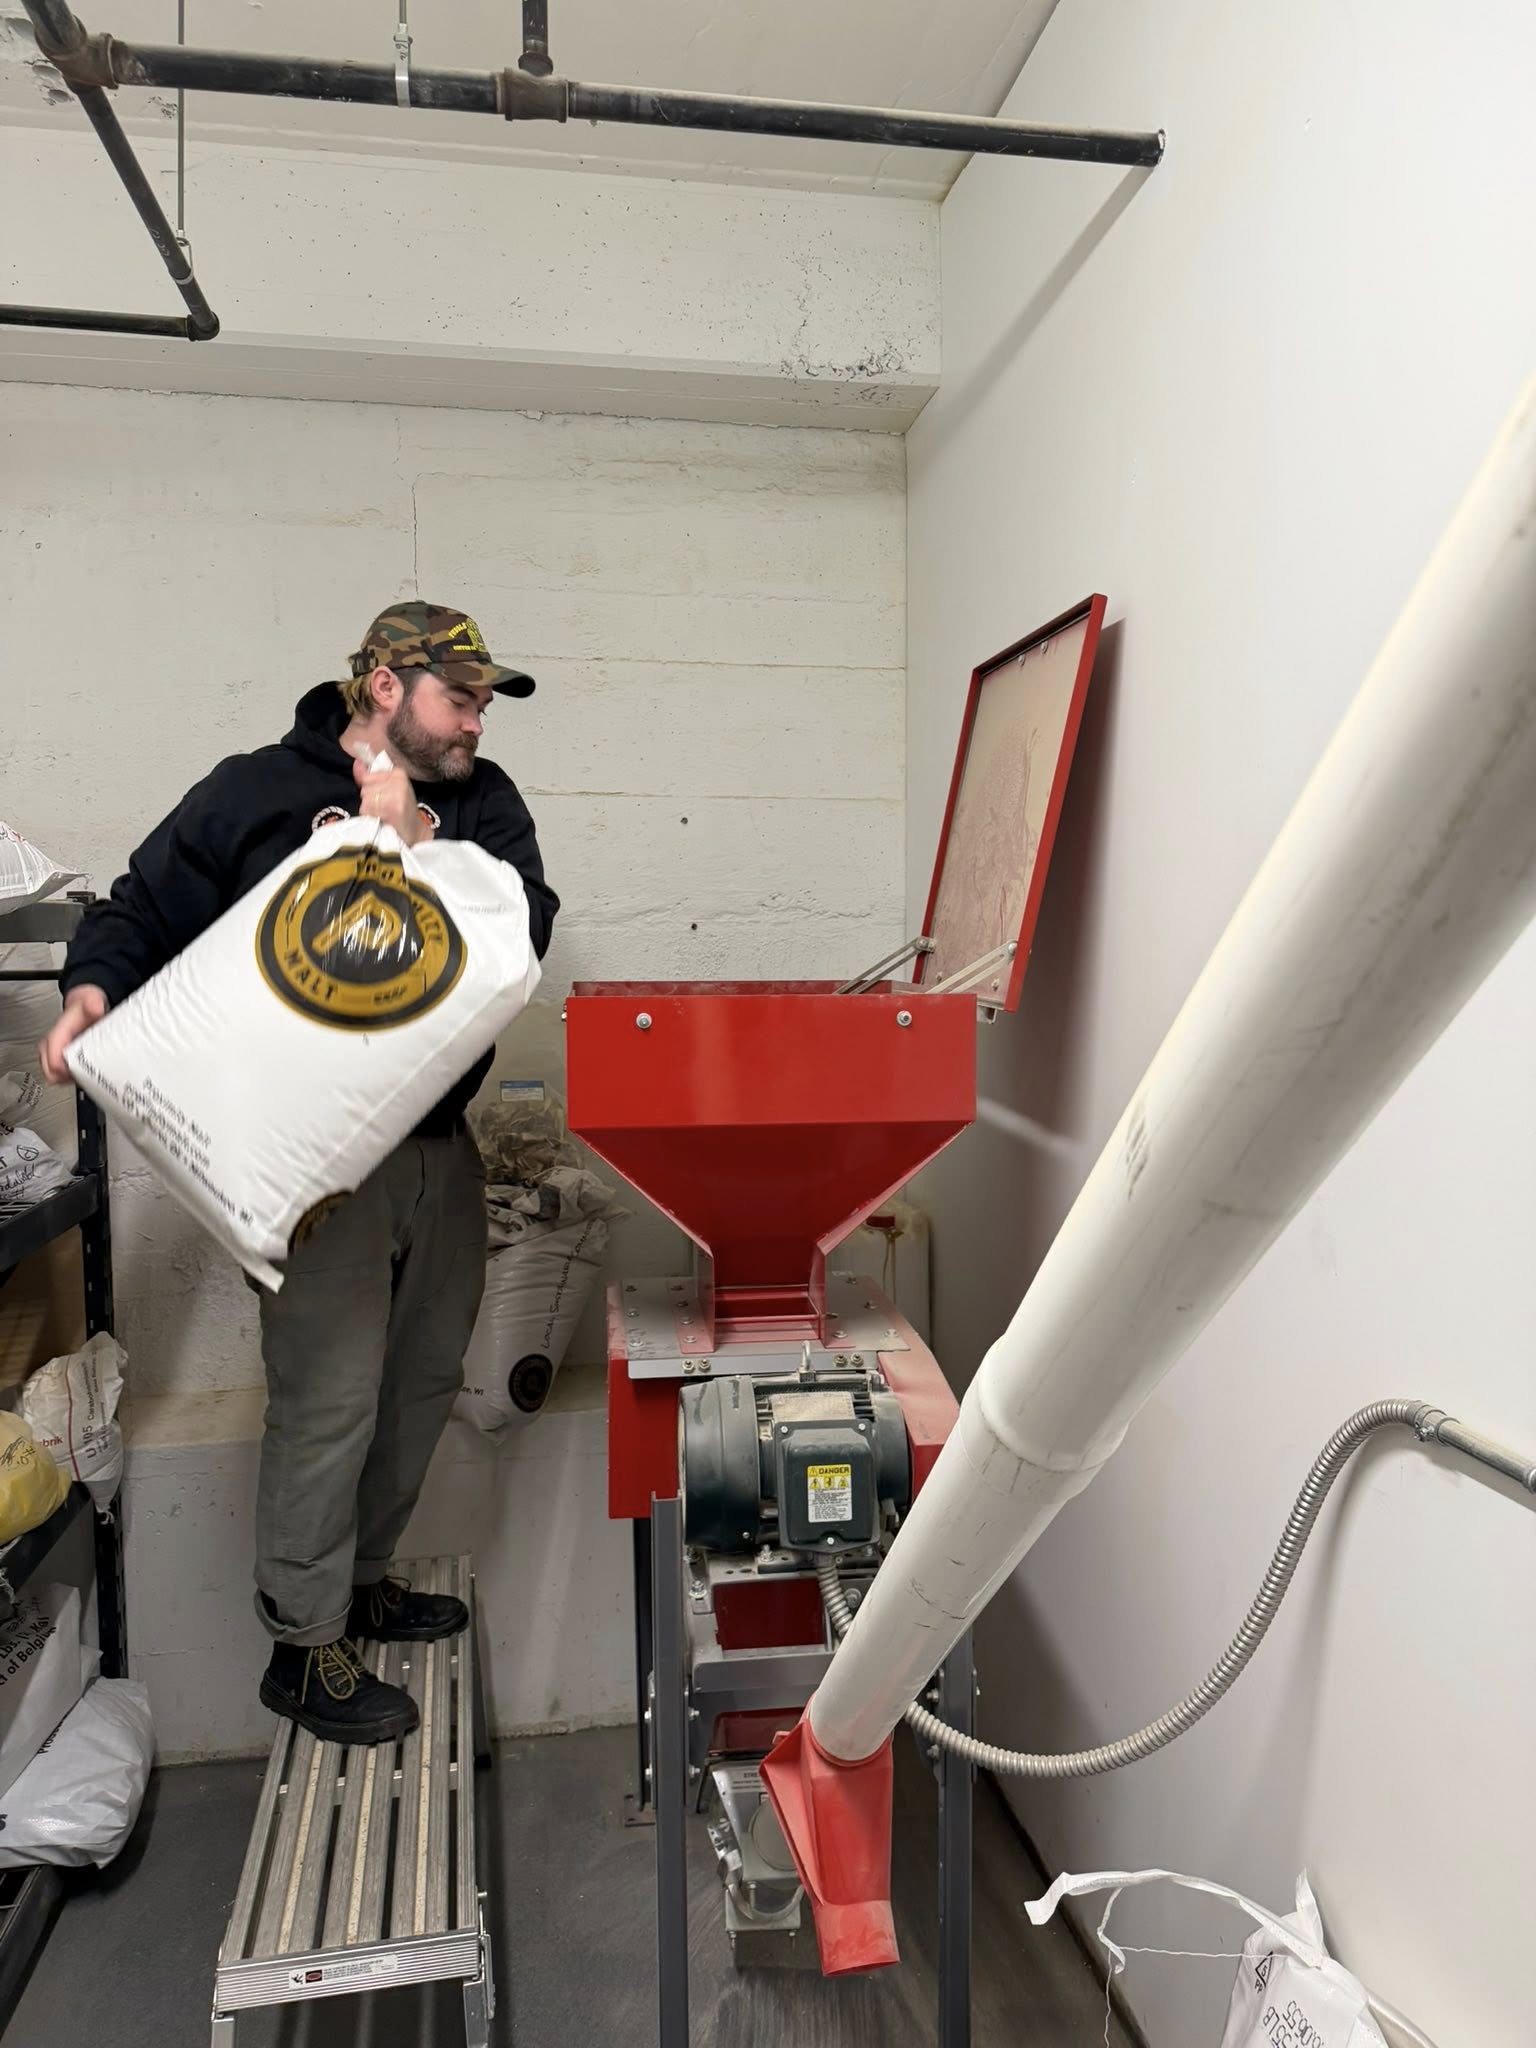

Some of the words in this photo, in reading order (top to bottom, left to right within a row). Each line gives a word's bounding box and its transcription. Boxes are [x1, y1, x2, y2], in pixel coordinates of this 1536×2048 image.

[285, 950, 337, 1001] MALT
[40, 1436, 64, 1448] brik
[82, 1425, 94, 1447] 105
[87, 1448, 97, 1459] U
[819, 1467, 850, 1475] DANGER
[7, 1659, 21, 1676] of
